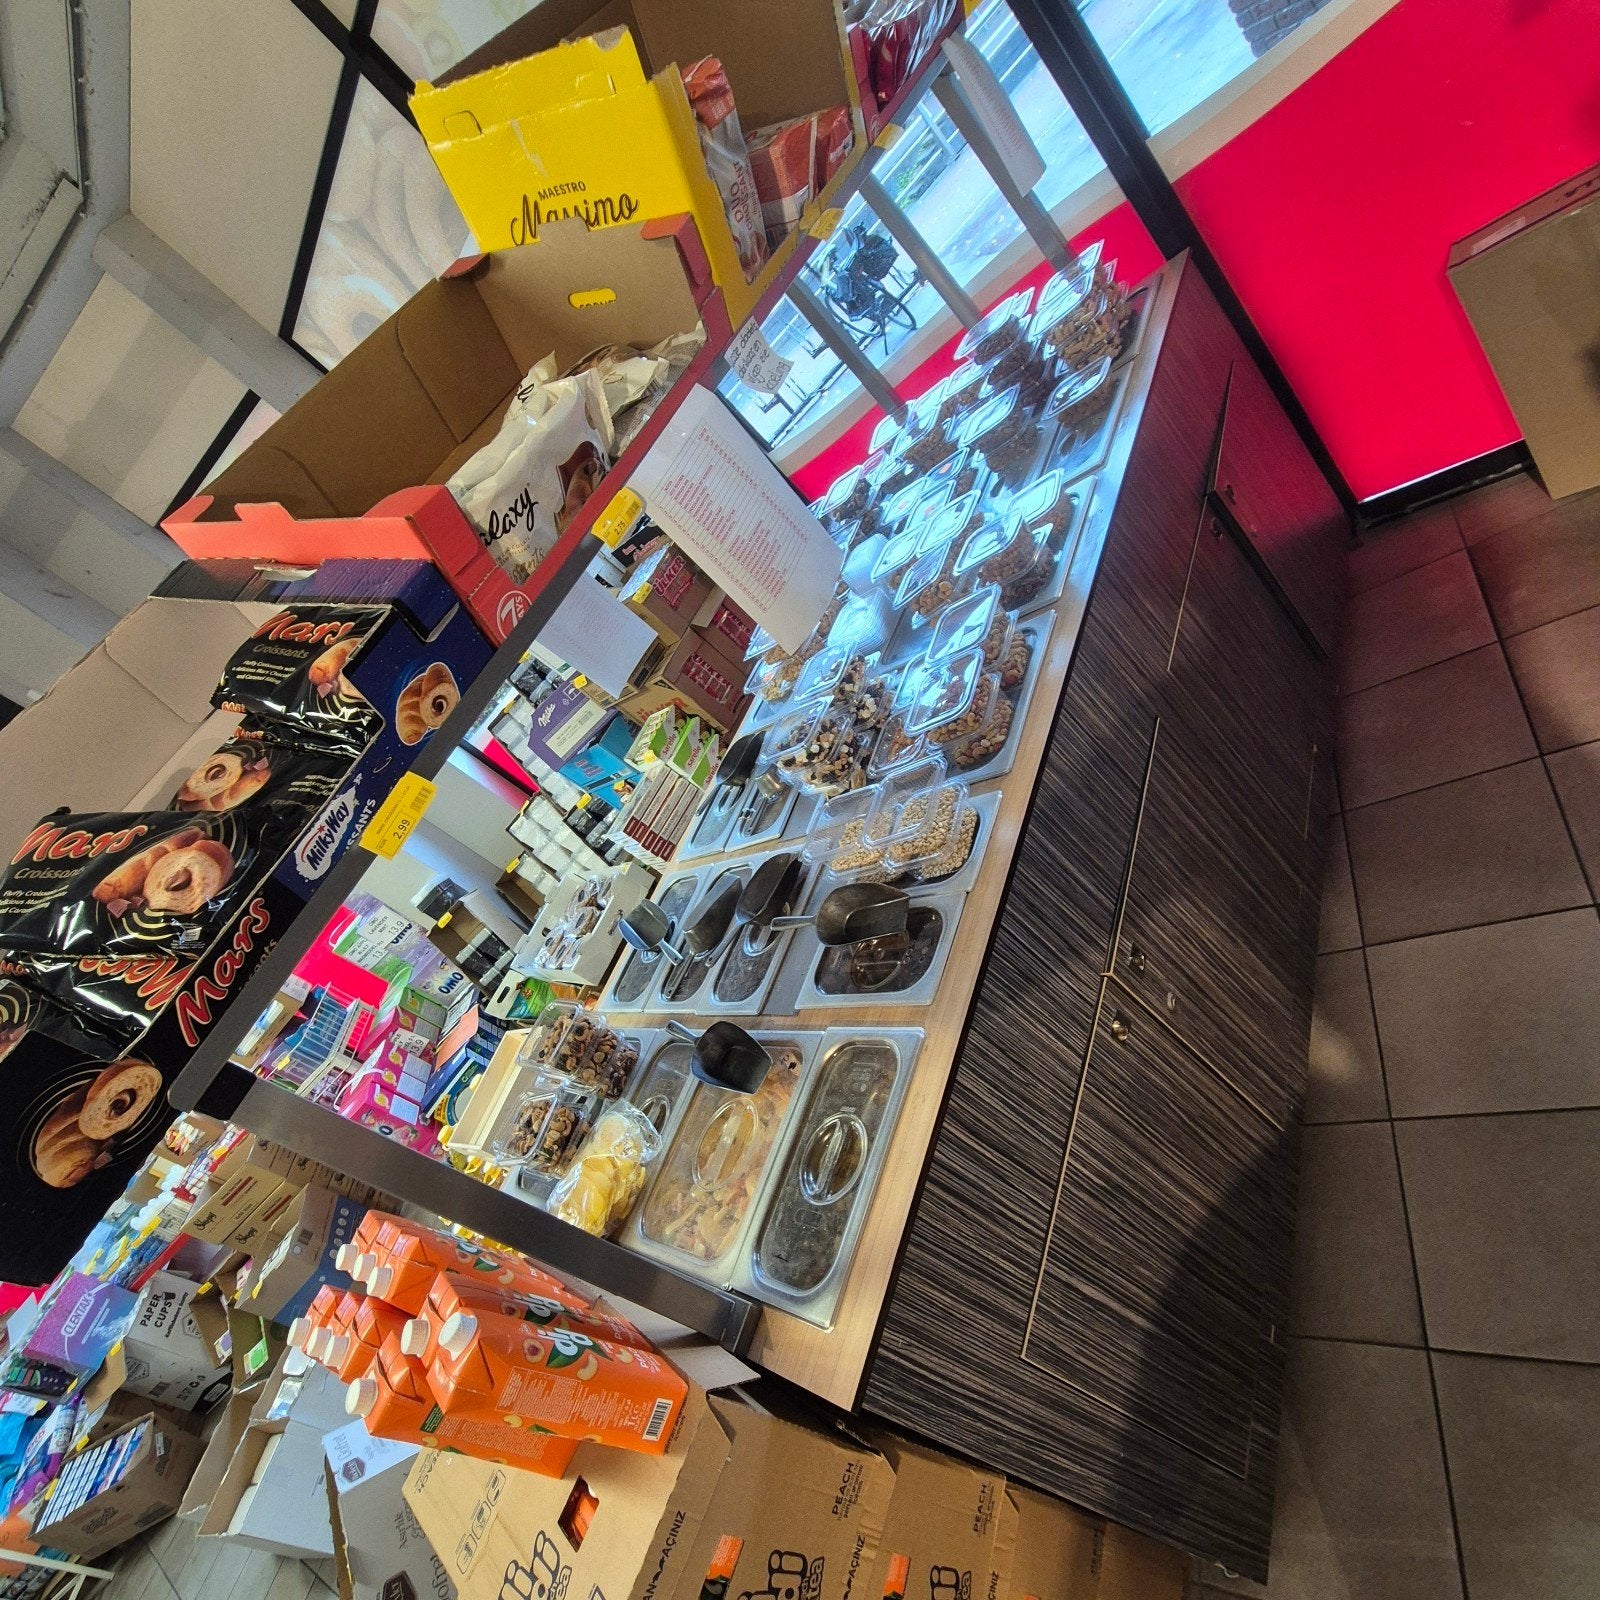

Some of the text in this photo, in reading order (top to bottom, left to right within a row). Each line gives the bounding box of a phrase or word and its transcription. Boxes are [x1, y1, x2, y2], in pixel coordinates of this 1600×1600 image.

[538, 181, 587, 201] MAESTRO
[479, 488, 538, 547] alaxy
[652, 555, 685, 597] ÜLKER
[250, 610, 356, 646] Mars
[253, 643, 310, 659] Croissants
[538, 702, 557, 728] Milka
[11, 821, 149, 865] Mars
[392, 817, 412, 840] 2,99
[368, 913, 388, 936] LAVENDER
[175, 897, 271, 1047] Mars
[437, 968, 464, 997] OMO
[64, 1292, 94, 1338] CLENTAX
[139, 1291, 162, 1328] PAPER
[153, 1299, 174, 1329] CUPS
[832, 1462, 856, 1517] PEACH
[973, 1484, 988, 1534] PEACH
[662, 1509, 687, 1557] AÇINIZ
[850, 1535, 866, 1577] AÇINIZ
[986, 1570, 999, 1600] ÇINIZ
